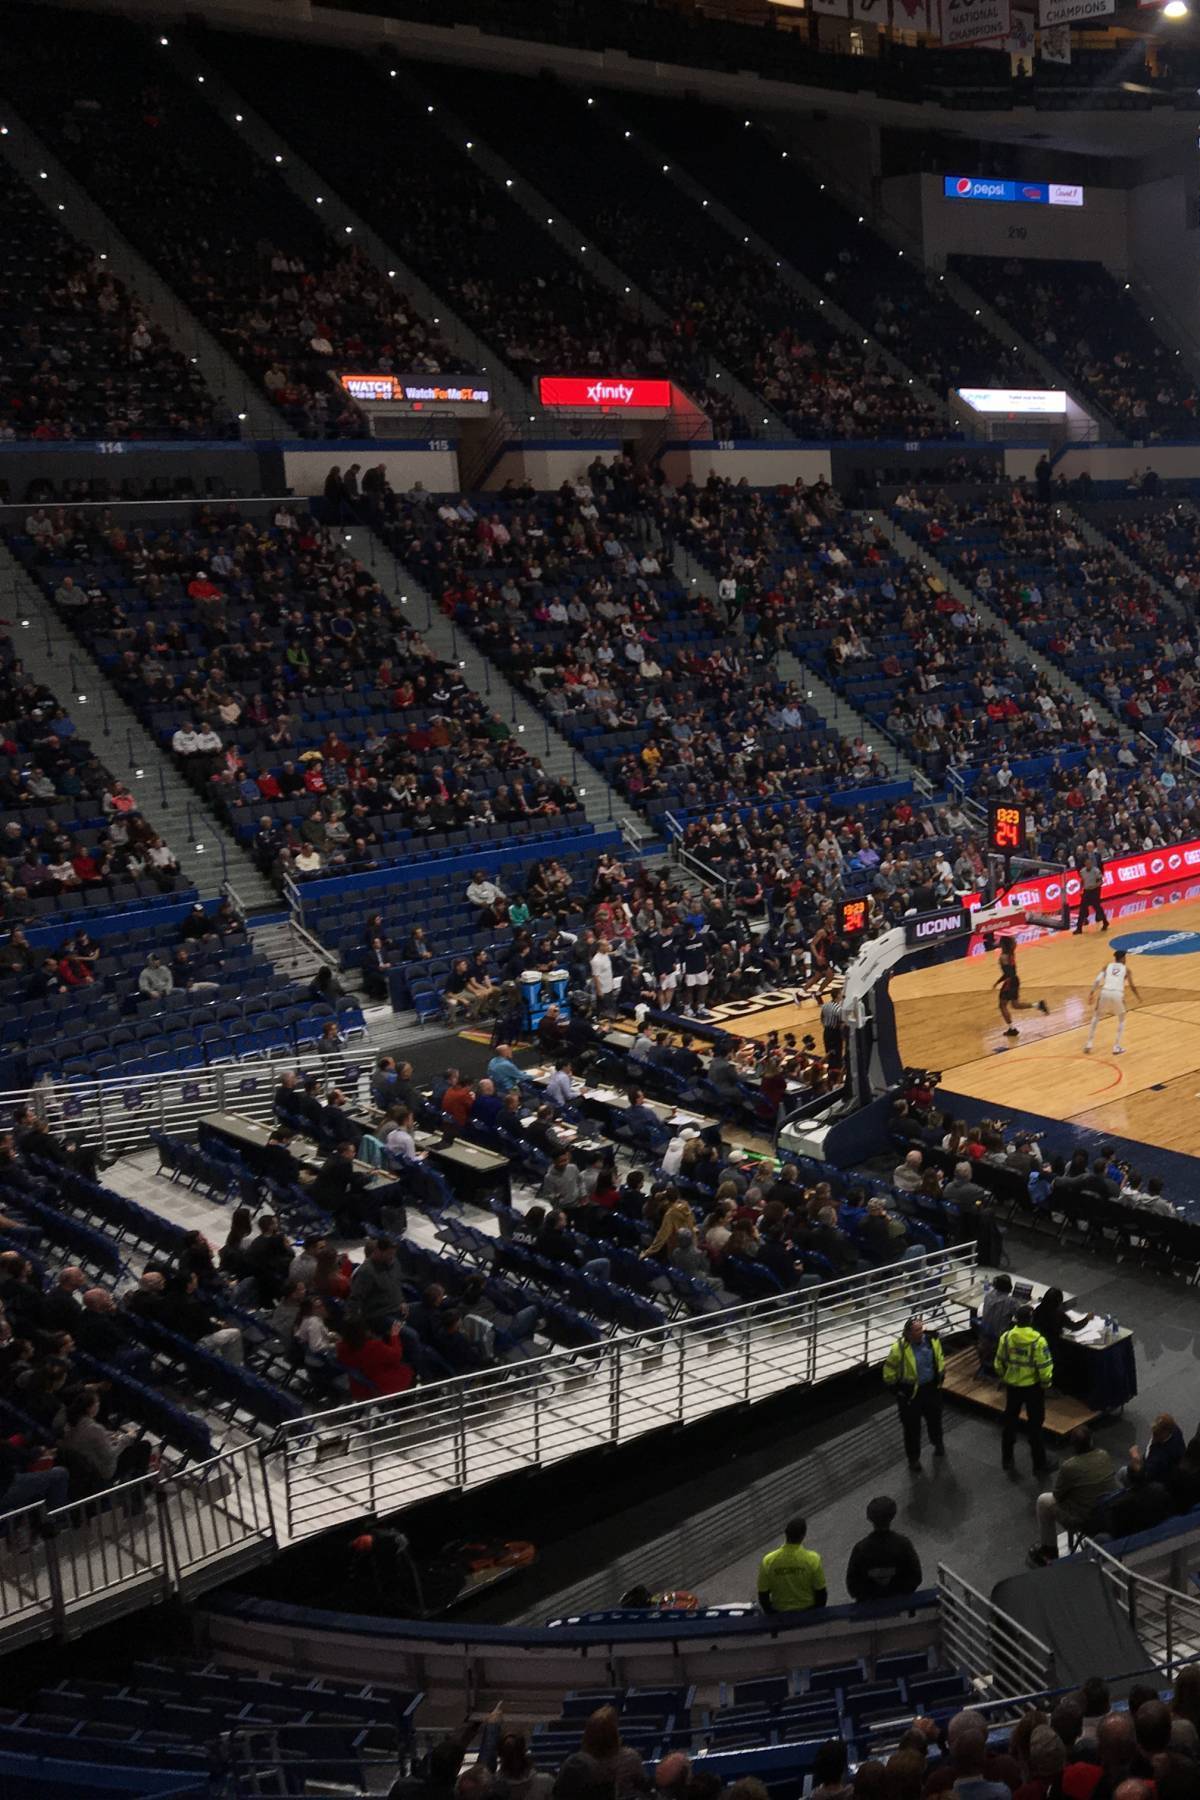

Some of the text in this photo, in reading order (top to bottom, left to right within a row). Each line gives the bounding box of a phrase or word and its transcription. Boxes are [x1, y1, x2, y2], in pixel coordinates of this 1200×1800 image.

[952, 8, 999, 24] NATIONAL
[1046, 4, 1107, 21] CHAMPIONS
[973, 183, 1005, 196] pepsi
[348, 381, 392, 392] WATCH
[587, 381, 634, 403] xfinity
[98, 441, 123, 454] 114
[428, 440, 449, 451] 115
[996, 822, 1017, 846] 24
[845, 912, 863, 931] 24
[916, 915, 961, 937] UCONN
